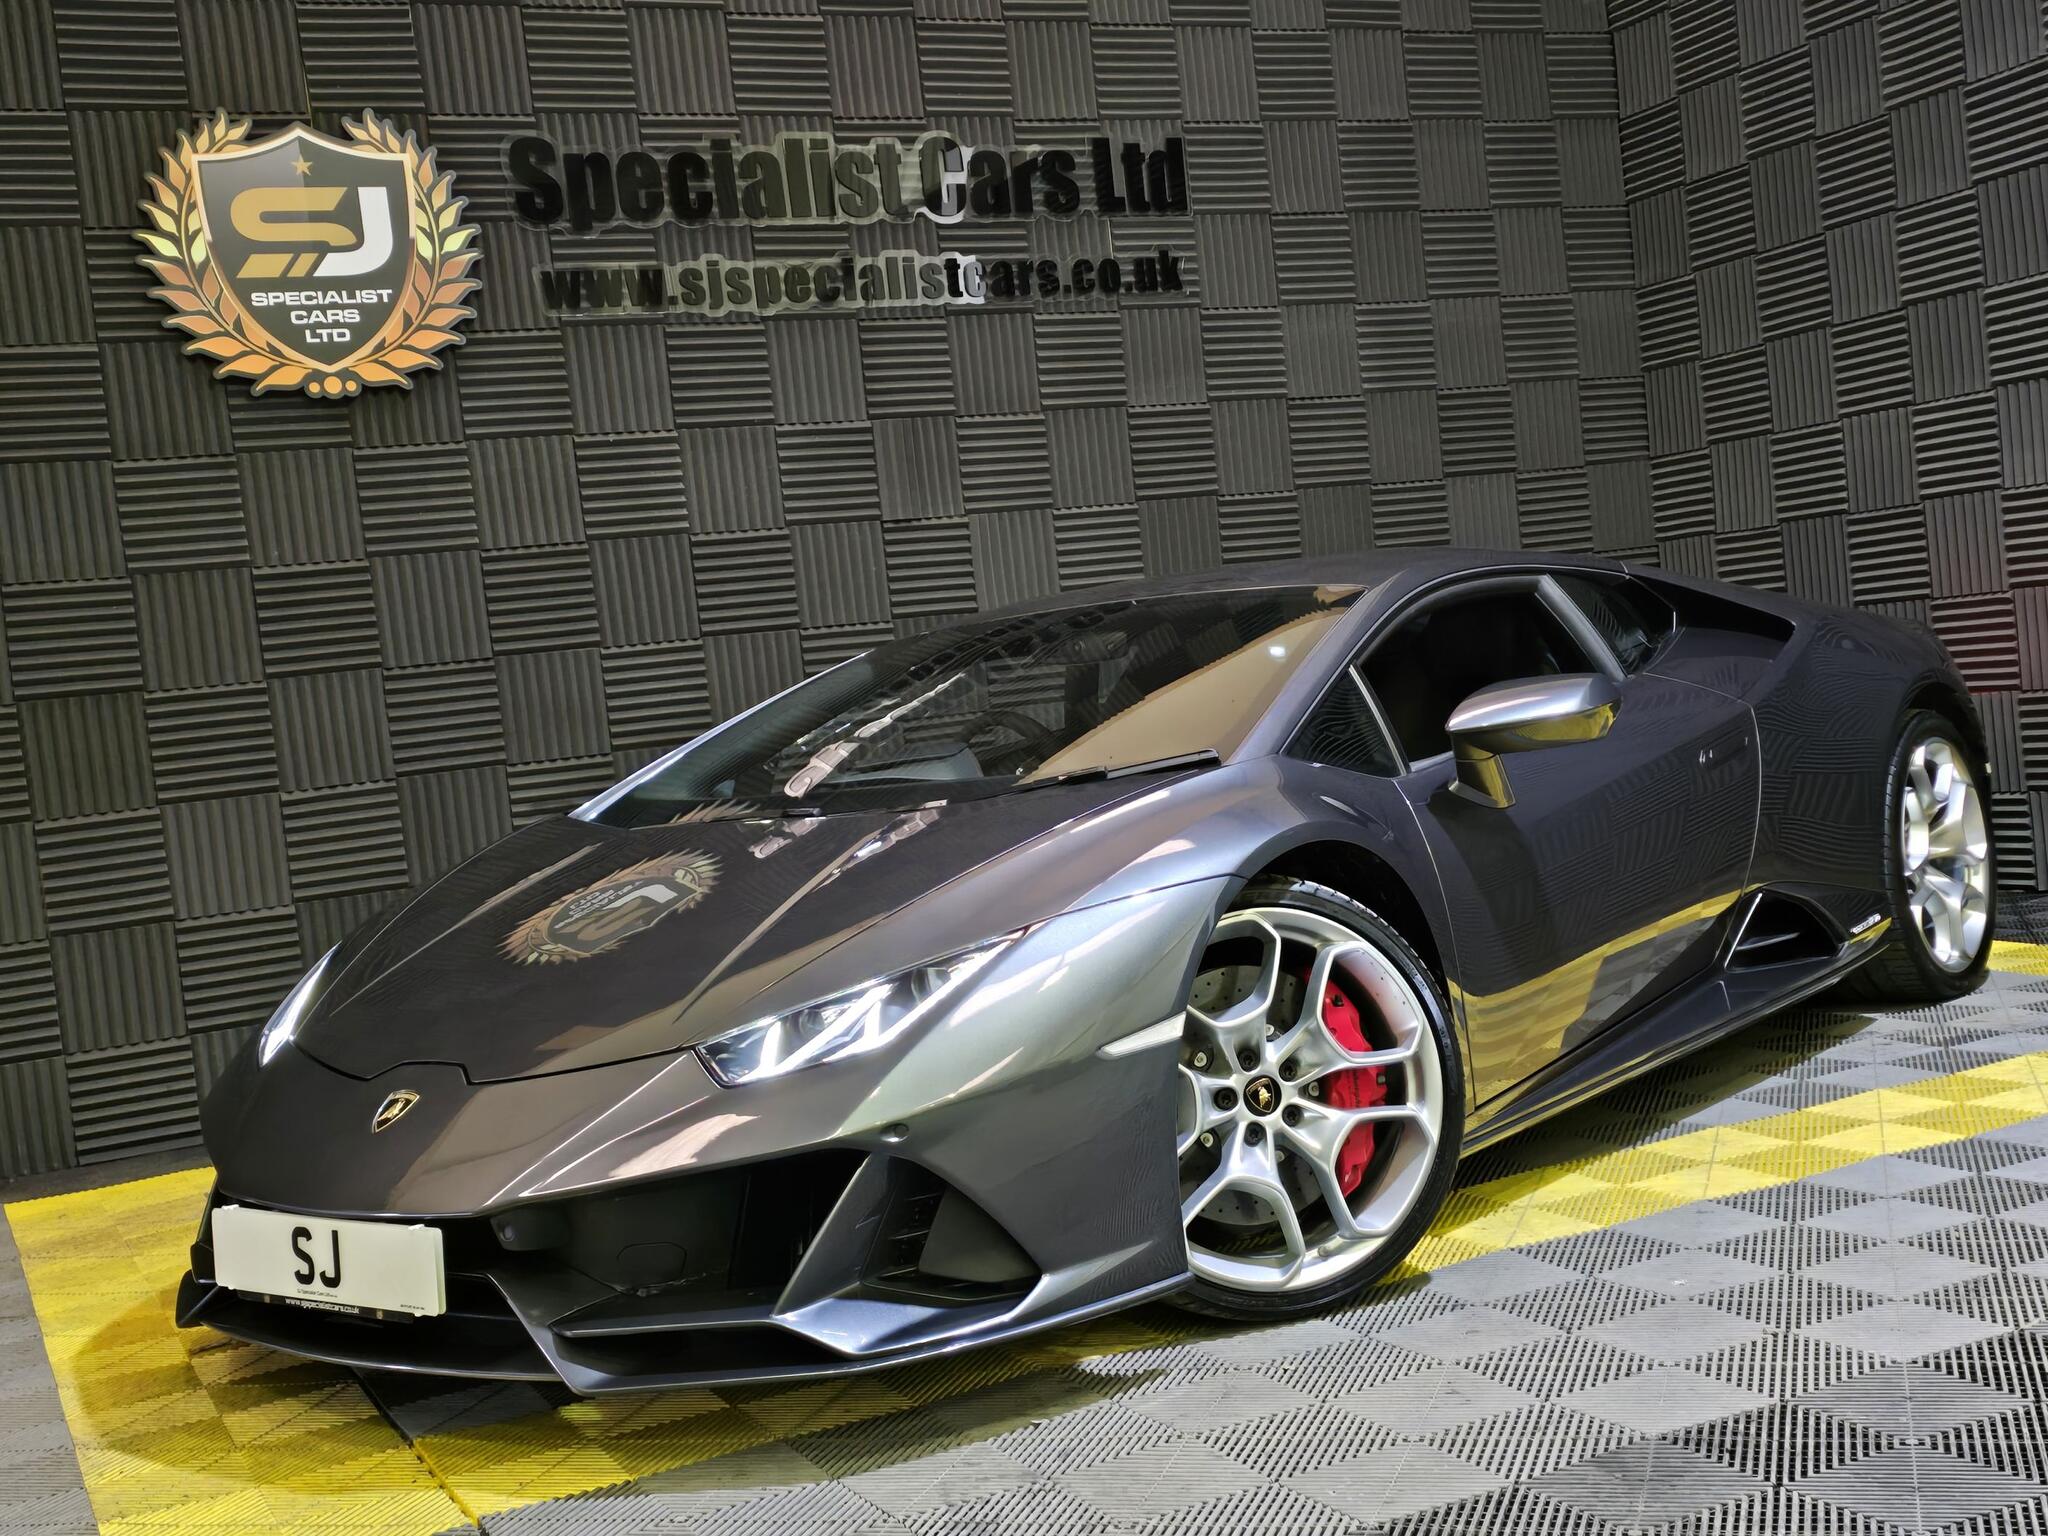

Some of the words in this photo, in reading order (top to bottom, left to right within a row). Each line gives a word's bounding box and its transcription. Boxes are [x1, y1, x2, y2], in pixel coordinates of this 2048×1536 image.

[508, 136, 902, 231] Specialist
[919, 136, 1080, 216] Cars
[1091, 136, 1188, 213] Ltd
[230, 187, 393, 278] SJ
[250, 289, 393, 307] SPECIALIST
[540, 250, 1184, 310] www.sjspecialistcars.co.uk
[290, 309, 361, 325] CARS
[304, 328, 351, 344] LTD
[291, 1226, 342, 1289] SJ
